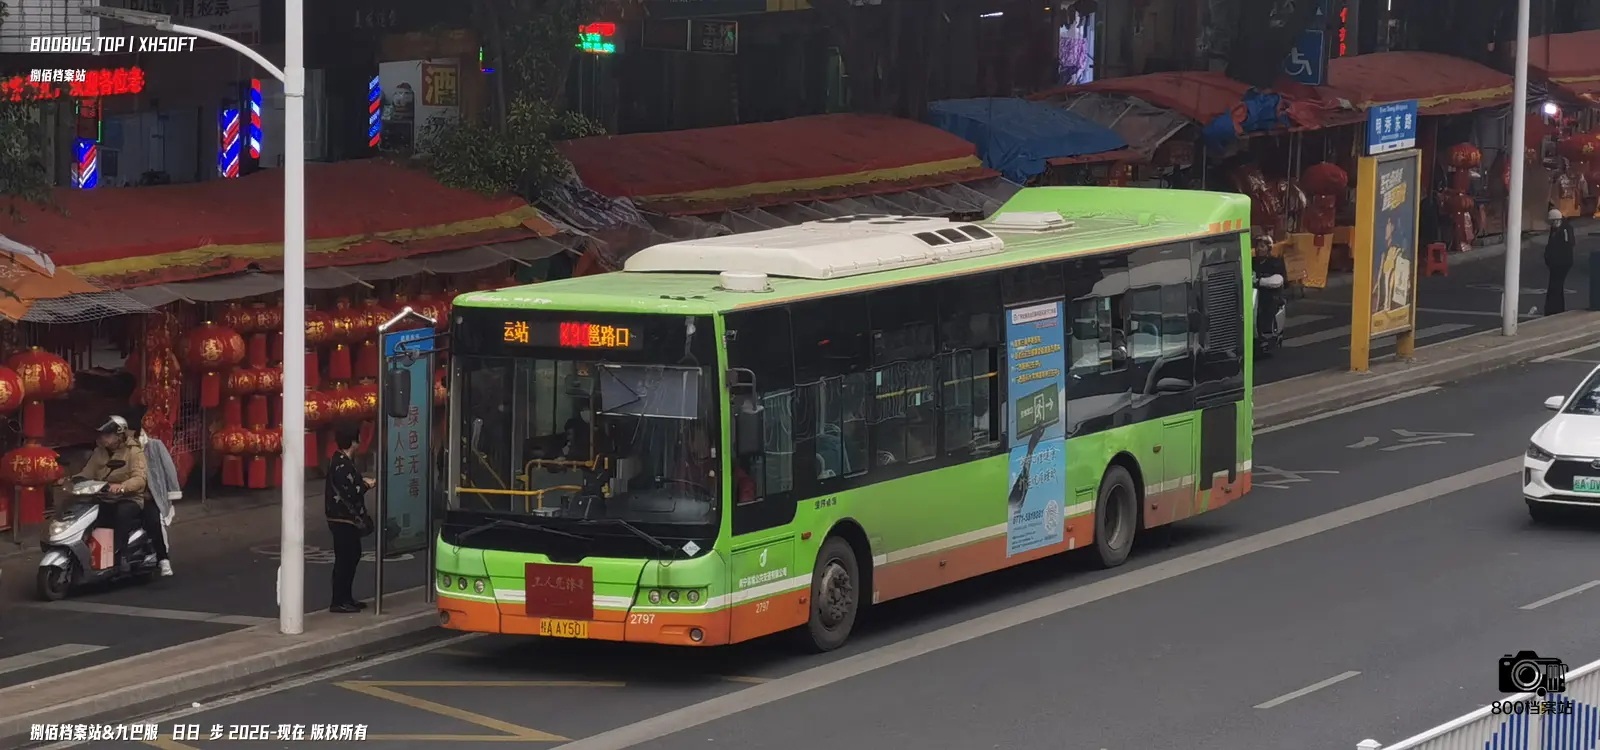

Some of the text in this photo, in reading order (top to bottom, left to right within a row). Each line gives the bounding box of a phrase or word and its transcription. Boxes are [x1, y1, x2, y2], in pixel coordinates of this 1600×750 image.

[424, 66, 457, 105] 酒
[755, 601, 770, 614] 2797
[630, 613, 656, 625] 2797
